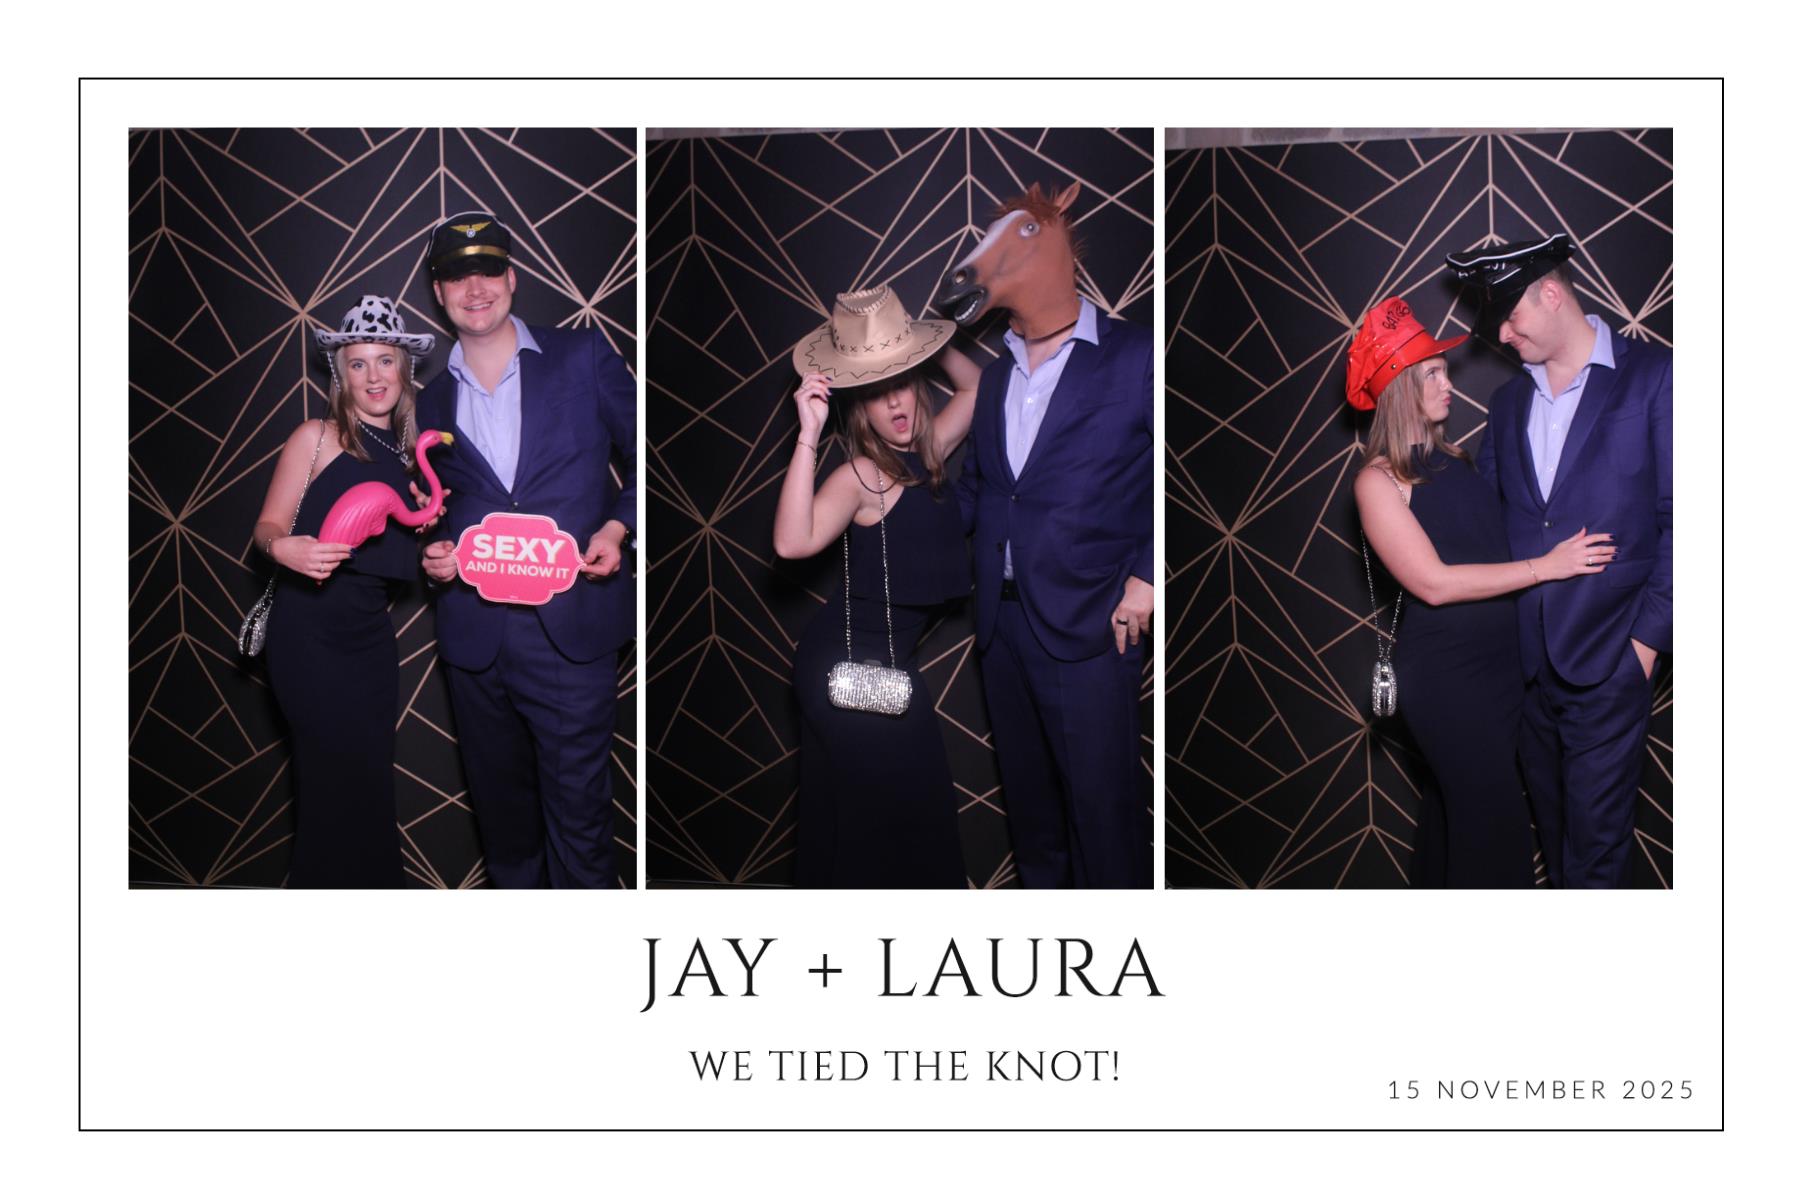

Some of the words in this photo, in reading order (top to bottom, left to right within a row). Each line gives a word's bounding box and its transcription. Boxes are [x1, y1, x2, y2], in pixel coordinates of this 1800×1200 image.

[472, 533, 565, 564] SEXY
[465, 560, 497, 574] AND
[500, 564, 505, 574] I
[507, 565, 553, 577] KNOW
[556, 567, 570, 579] IT
